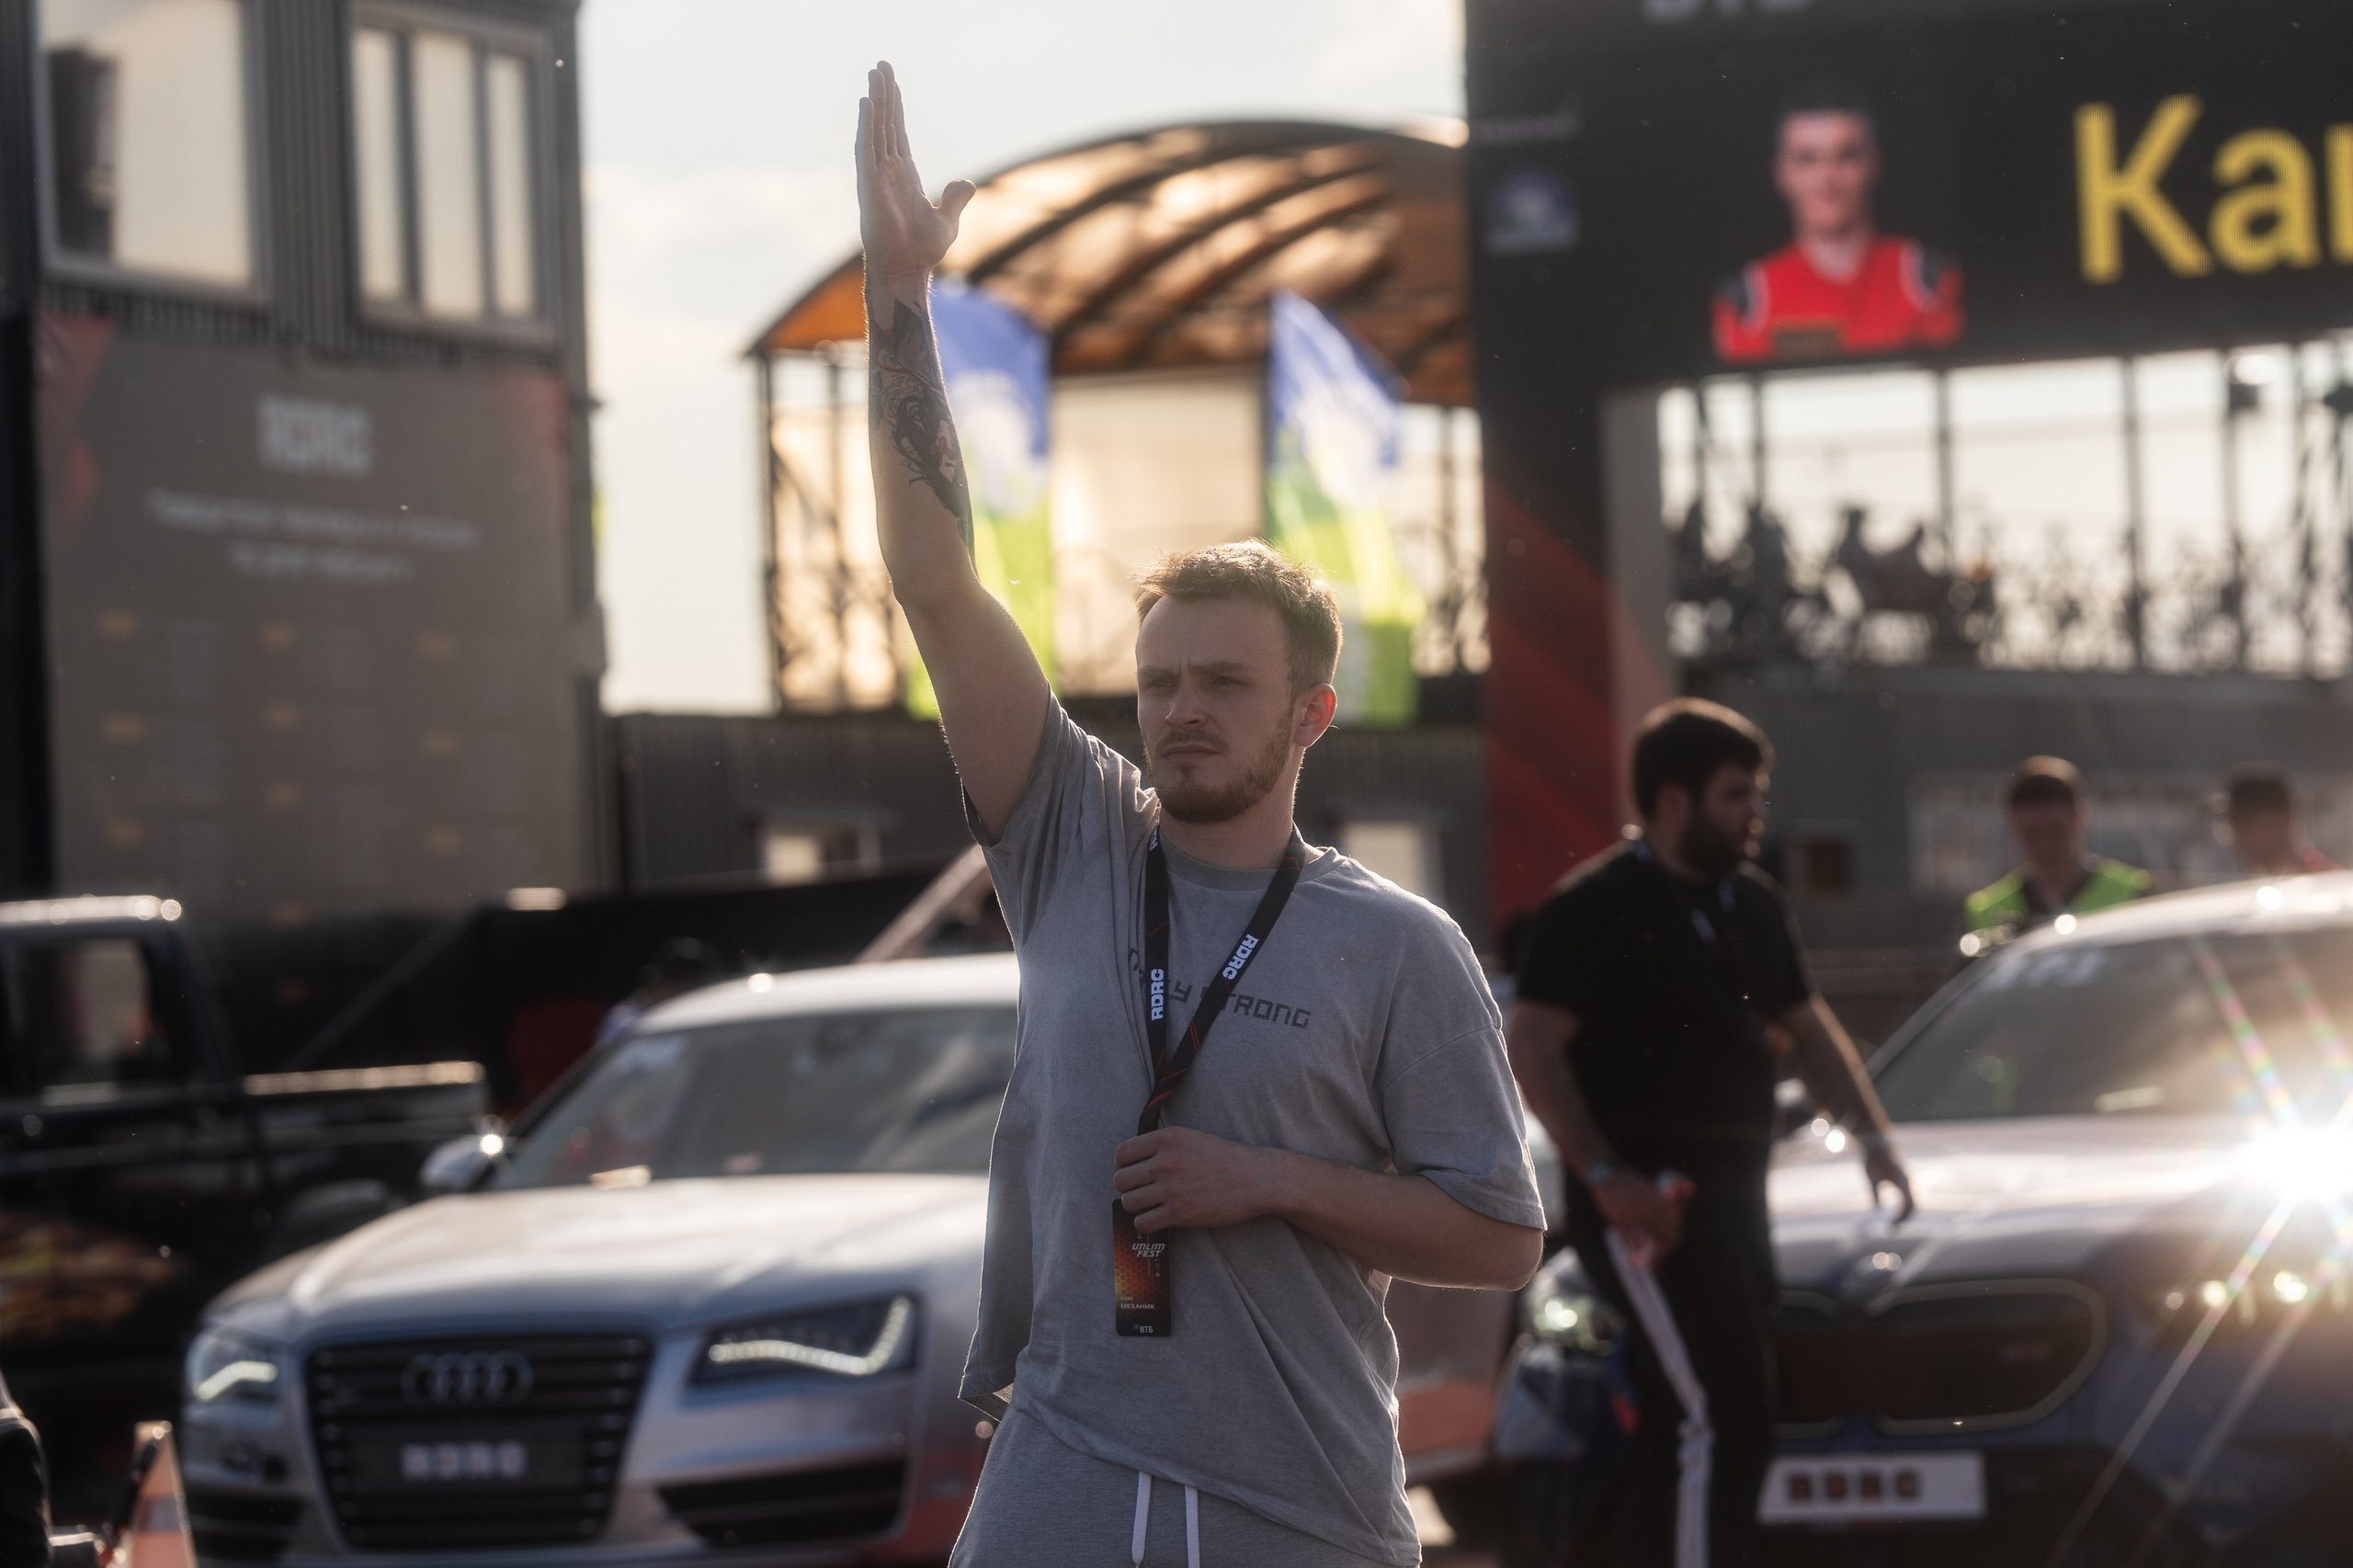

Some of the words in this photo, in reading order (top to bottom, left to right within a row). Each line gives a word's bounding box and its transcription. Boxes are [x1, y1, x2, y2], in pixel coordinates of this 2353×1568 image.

[1222, 934, 1259, 980] RDRC
[1151, 968, 1165, 1021] RDRC
[1200, 986, 1312, 1029] TRONG
[1131, 1243, 1165, 1251] UNLIM
[1140, 1325, 1154, 1334] ВТБ
